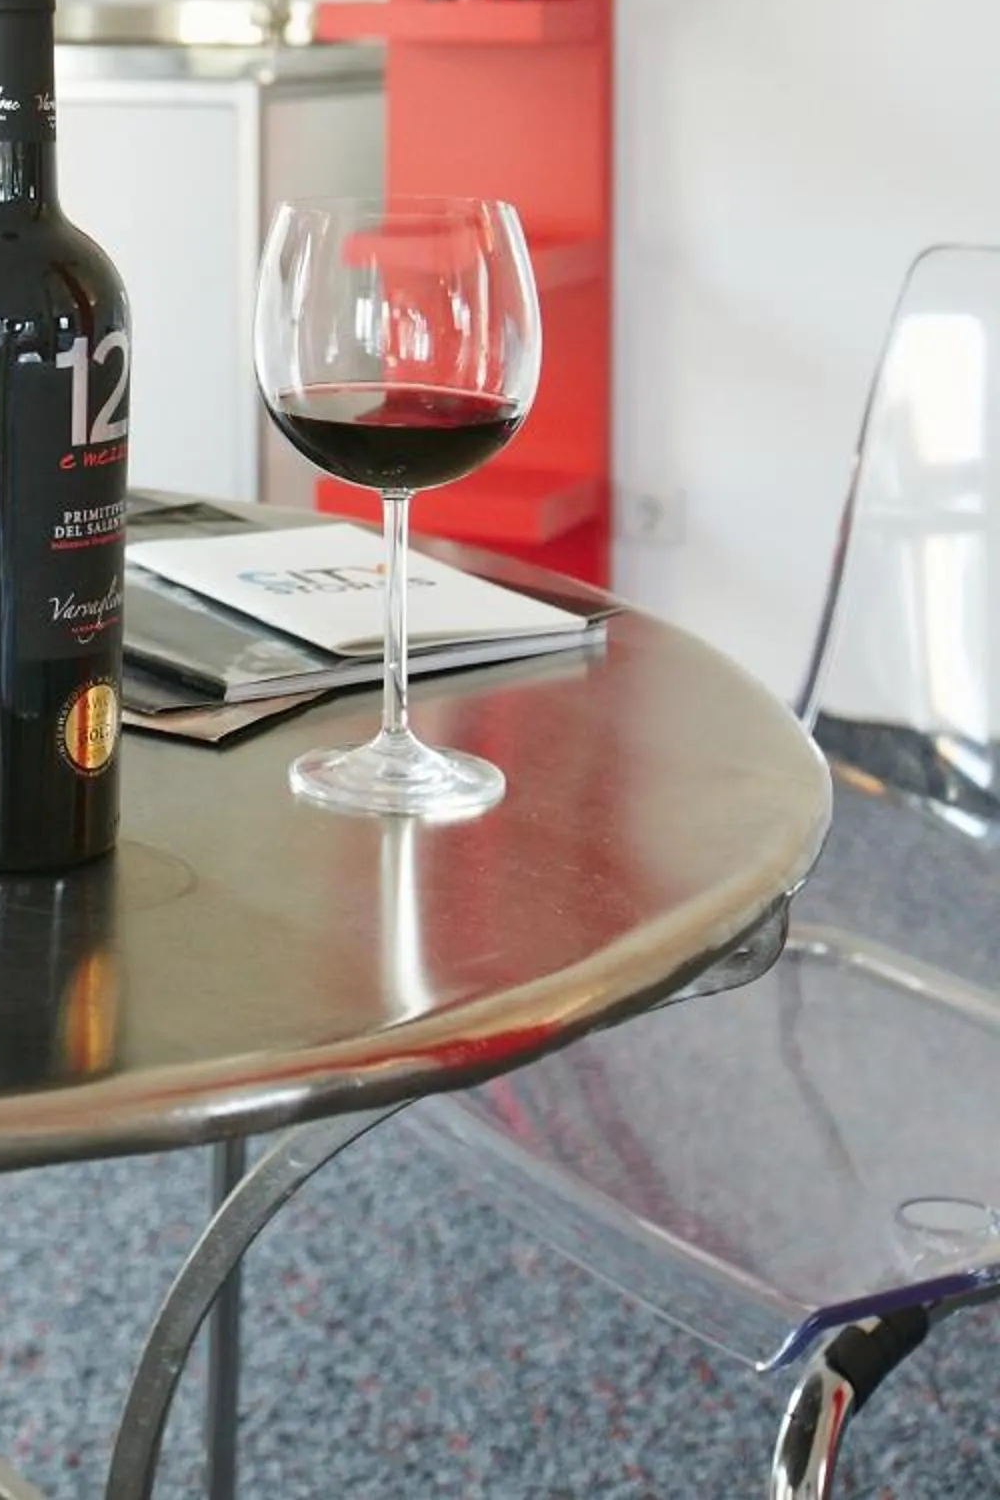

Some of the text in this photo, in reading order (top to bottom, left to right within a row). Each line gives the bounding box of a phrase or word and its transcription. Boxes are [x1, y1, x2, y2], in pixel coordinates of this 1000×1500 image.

[55, 330, 129, 447] 12
[58, 451, 77, 470] e
[54, 524, 83, 539] DEL
